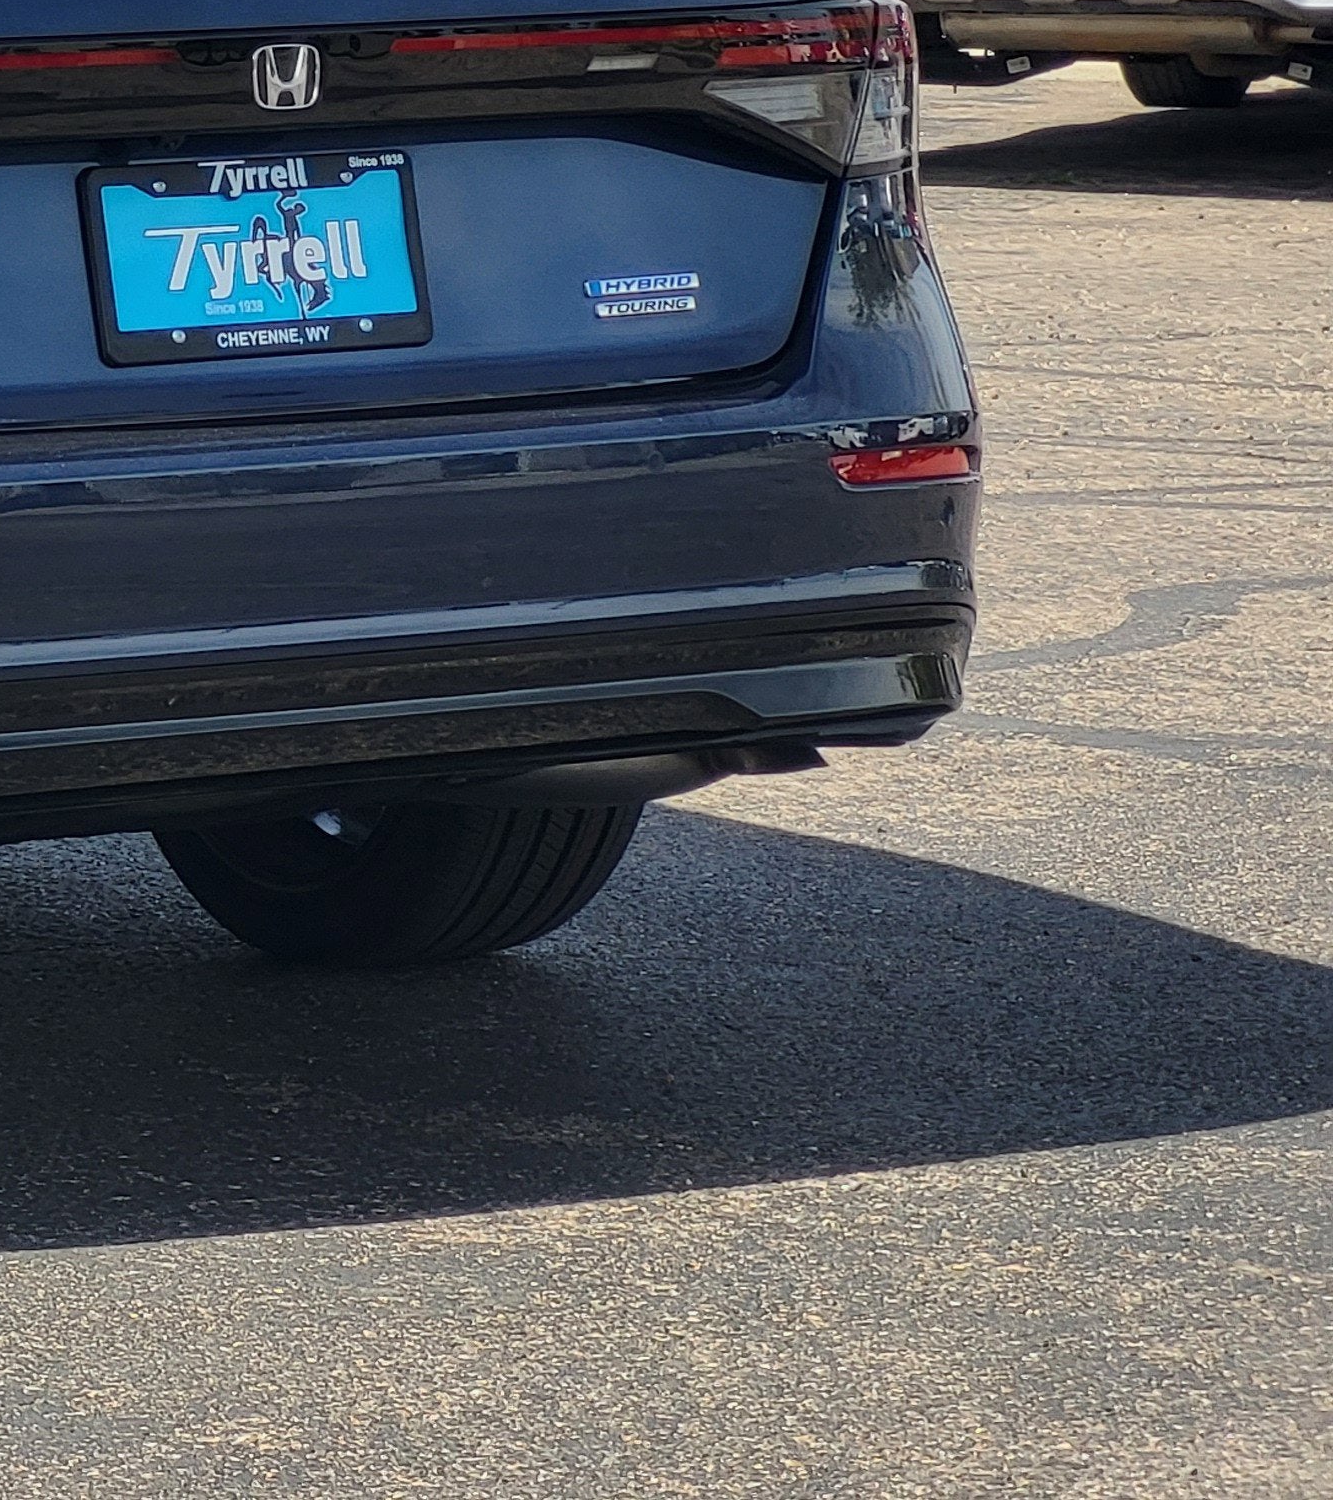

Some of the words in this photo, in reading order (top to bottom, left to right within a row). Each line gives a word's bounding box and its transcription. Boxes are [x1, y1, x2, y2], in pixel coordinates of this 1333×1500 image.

[197, 157, 309, 198] Tyrrell
[348, 155, 378, 169] Since
[378, 153, 405, 167] 1938
[143, 219, 368, 300] Tyrrell
[605, 274, 692, 294] HYBRID
[204, 302, 236, 316] Since
[237, 299, 264, 314] 1938
[605, 298, 690, 315] TOURING
[216, 327, 304, 349] CHEYENNE,
[304, 325, 332, 342] WY
